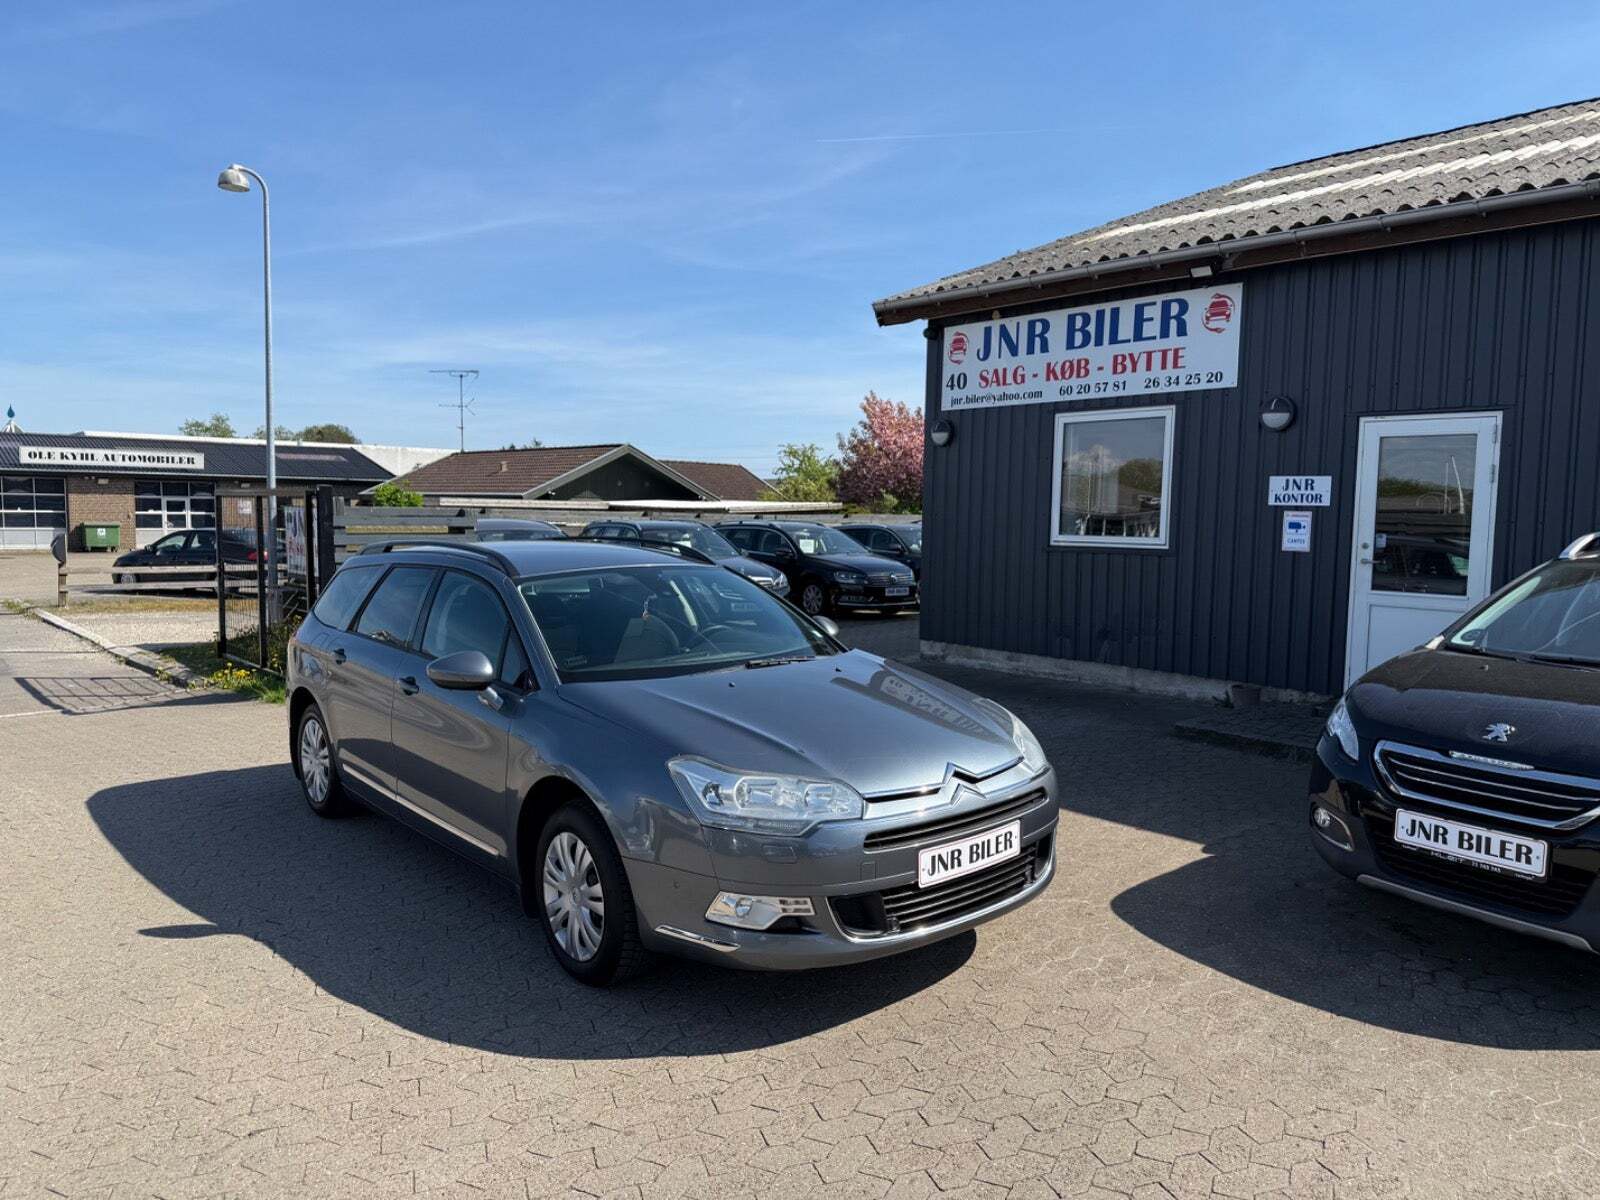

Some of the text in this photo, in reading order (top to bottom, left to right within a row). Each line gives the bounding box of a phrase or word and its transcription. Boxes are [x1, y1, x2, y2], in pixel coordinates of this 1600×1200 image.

[976, 298, 1189, 362] JNR BILER
[945, 372, 968, 391] 40
[978, 365, 1026, 389] SALG
[1045, 357, 1090, 382] KØB
[1112, 347, 1187, 375] BYTTE
[950, 371, 1223, 407] jnr.biler@yahoo.com 60 20 57 81 26 34 25 20
[27, 451, 56, 460] OLE
[102, 453, 196, 465] AUTOMOBILER
[1274, 493, 1323, 503] KONTOR
[1283, 478, 1315, 491] JNR
[927, 831, 1013, 876] JNR BILER
[1406, 819, 1534, 866] JNR BILER
